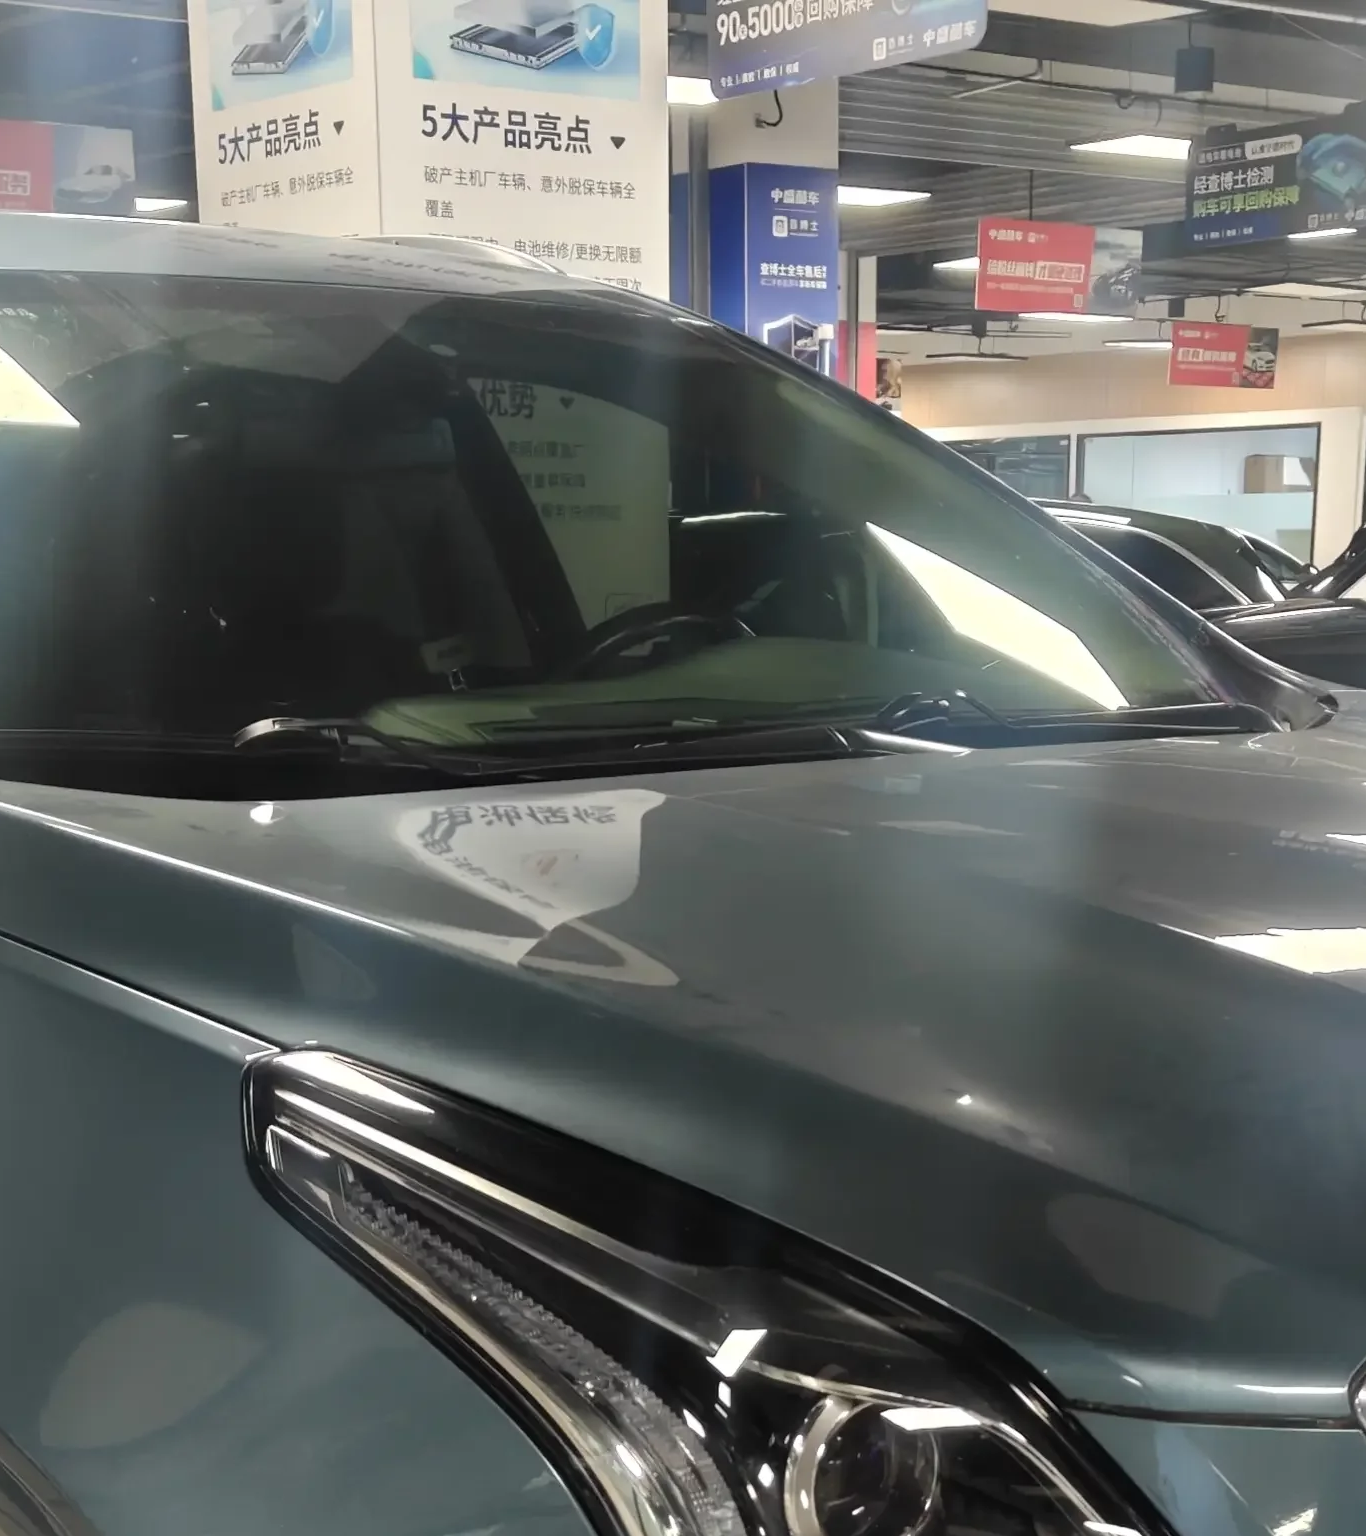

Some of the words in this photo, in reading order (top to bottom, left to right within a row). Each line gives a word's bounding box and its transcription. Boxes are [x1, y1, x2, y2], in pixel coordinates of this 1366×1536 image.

[218, 109, 322, 164] 5大产品亮点
[421, 102, 592, 154] 5大产品亮点
[1193, 164, 1274, 195] 经查博士检测
[425, 199, 454, 219] 覆盖
